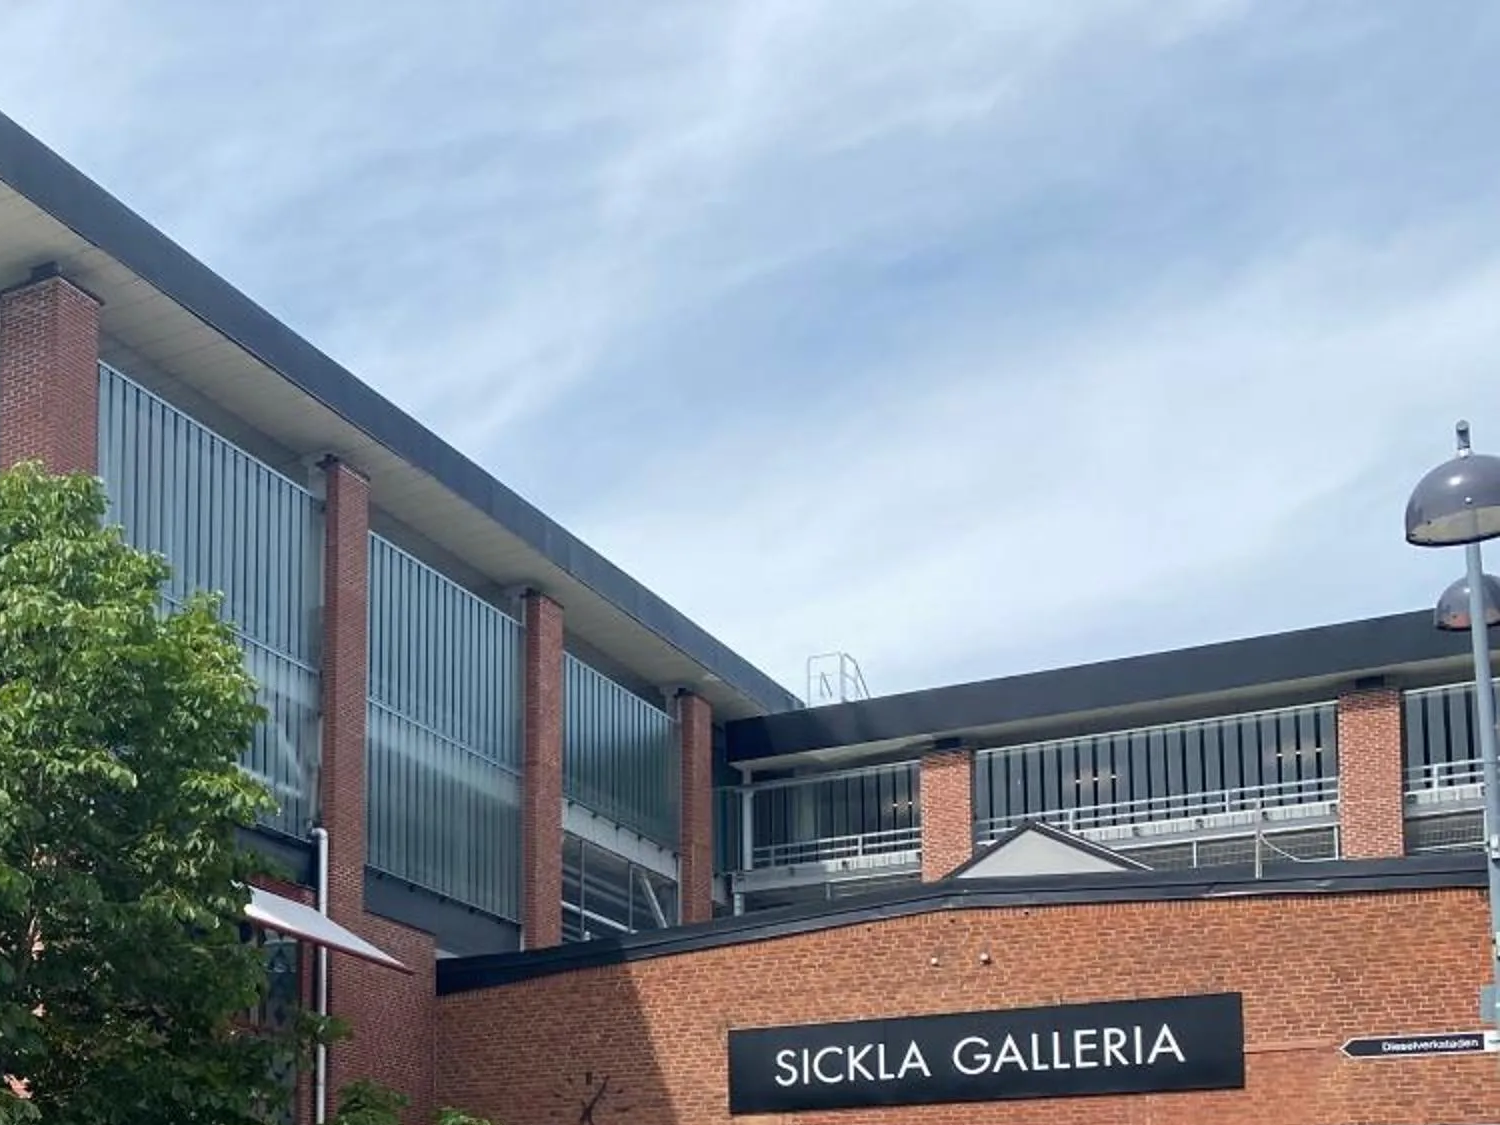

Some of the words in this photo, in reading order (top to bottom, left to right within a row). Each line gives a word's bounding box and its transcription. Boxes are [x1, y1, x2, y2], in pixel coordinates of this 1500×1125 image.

[774, 1039, 932, 1087] SICKLA
[952, 1022, 1187, 1076] GALLERIA
[1381, 1038, 1479, 1052] Dieselverkstaden
